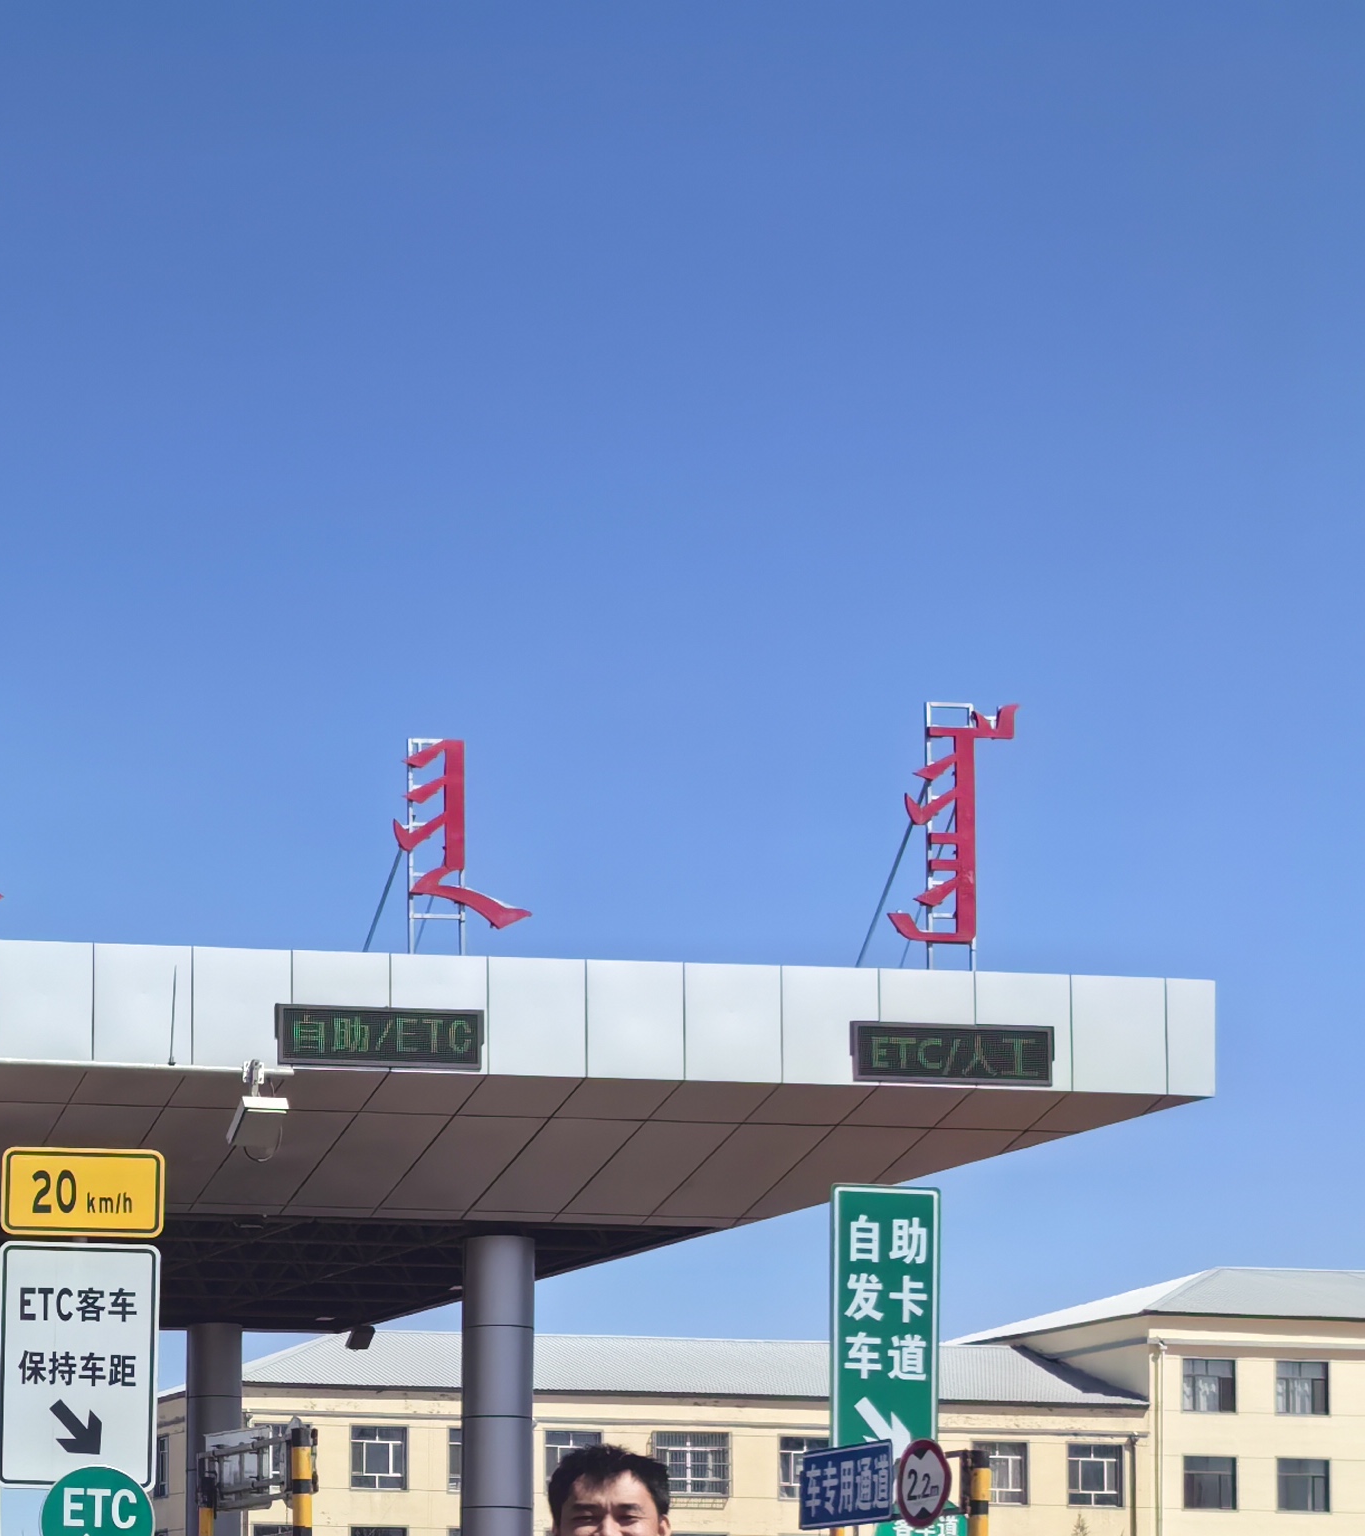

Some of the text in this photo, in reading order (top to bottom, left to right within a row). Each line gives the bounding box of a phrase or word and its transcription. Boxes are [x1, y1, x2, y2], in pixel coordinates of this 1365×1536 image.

[294, 1013, 472, 1053] 自助/ETC
[871, 1034, 1039, 1077] ETC/人工
[32, 1169, 133, 1214] 20 km/h
[849, 1215, 928, 1264] 自助
[18, 1287, 138, 1323] ETC客车
[844, 1273, 928, 1323] 发卡
[18, 1350, 137, 1387] 保持车距
[844, 1331, 927, 1381] 车道
[805, 1454, 889, 1517] 车专用通道
[62, 1488, 138, 1529] ETC
